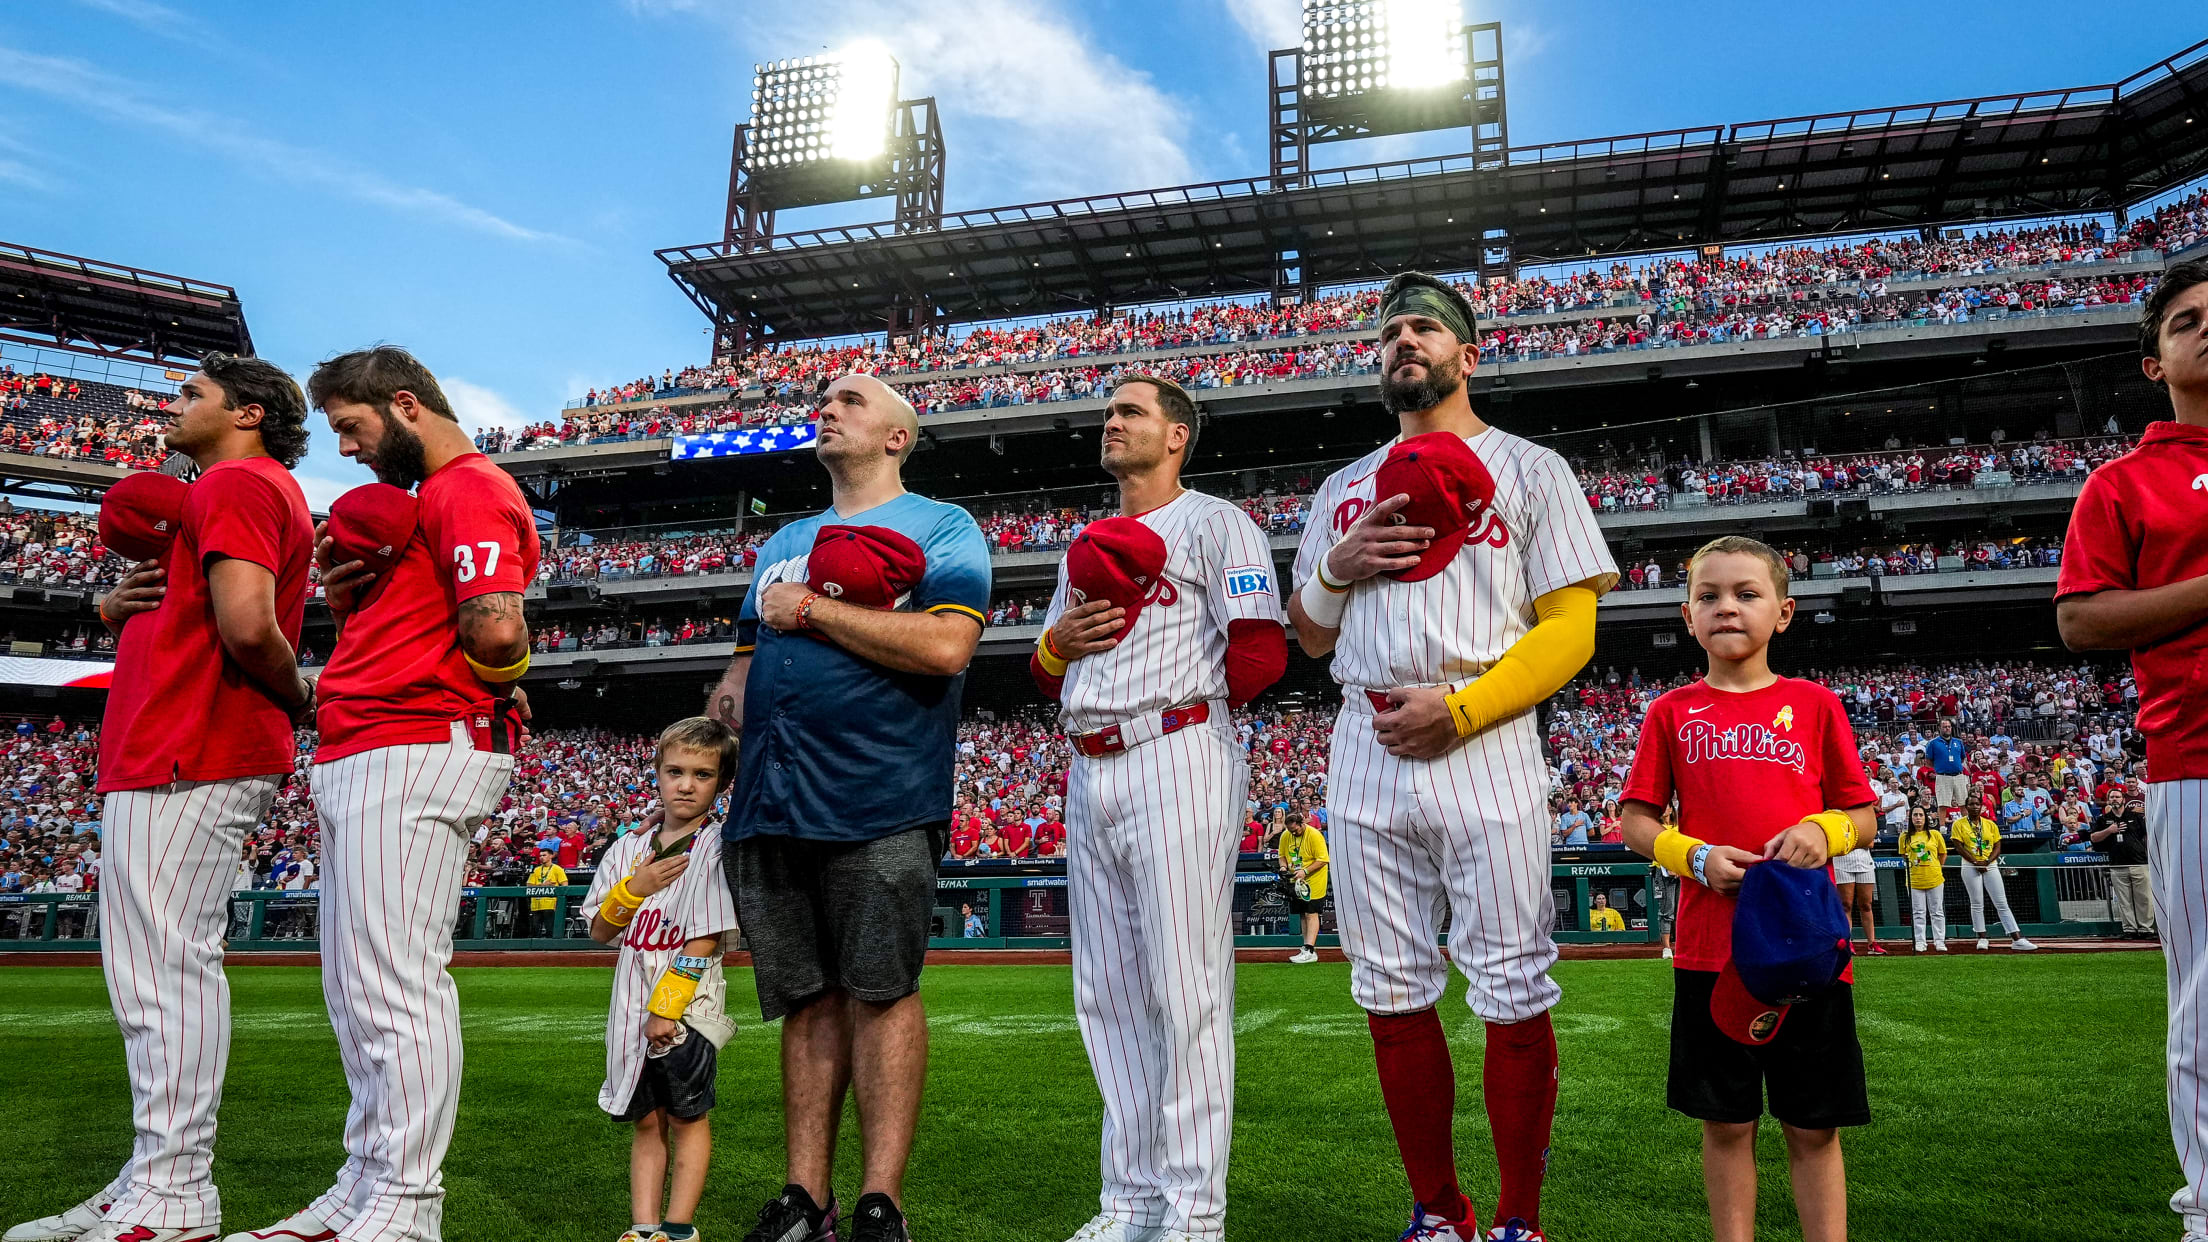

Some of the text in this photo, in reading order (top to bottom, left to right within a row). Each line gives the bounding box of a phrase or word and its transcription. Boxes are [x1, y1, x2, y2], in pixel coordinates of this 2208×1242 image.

[453, 541, 500, 583] 37
[1229, 573, 1271, 595] IBX
[823, 582, 843, 598] P
[1679, 719, 1805, 769] Phillies
[1873, 860, 1900, 868] water
[2064, 855, 2109, 864] smartwat
[1571, 866, 1612, 875] RE/MAX
[1027, 878, 1068, 886] smartwater
[1235, 873, 1276, 882] smartwater
[526, 887, 556, 896] RE/MAX
[624, 908, 686, 952] illie
